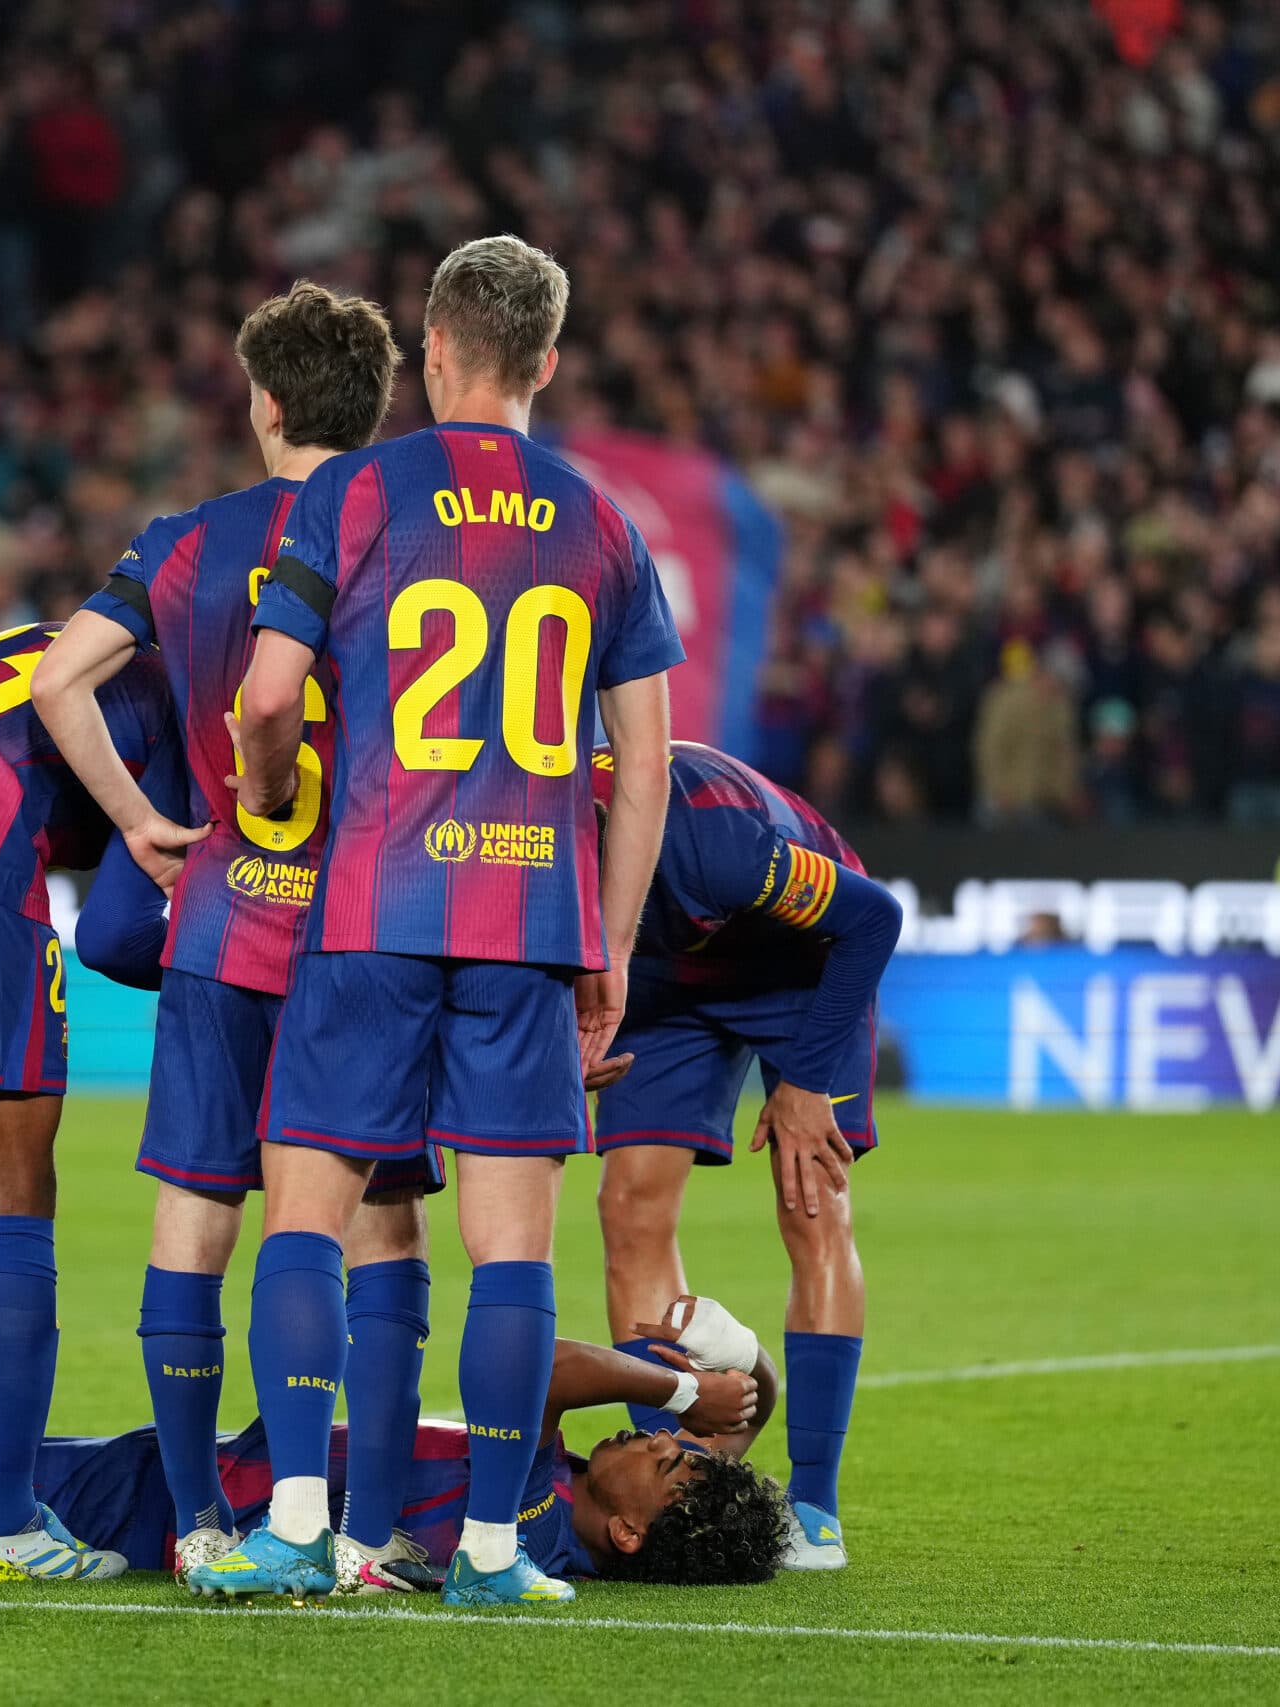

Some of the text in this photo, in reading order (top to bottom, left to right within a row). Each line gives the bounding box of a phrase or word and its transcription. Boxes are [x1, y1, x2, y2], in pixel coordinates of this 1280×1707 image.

[433, 487, 556, 532] OLMO
[388, 578, 592, 777] 20
[480, 822, 555, 843] UNHCR
[479, 839, 554, 860] ACNUR
[266, 863, 318, 884] UNHC
[265, 880, 314, 899] ACN
[45, 938, 66, 1013] 2
[287, 1376, 336, 1394] BARÇA
[470, 1423, 521, 1440] BARÇA
